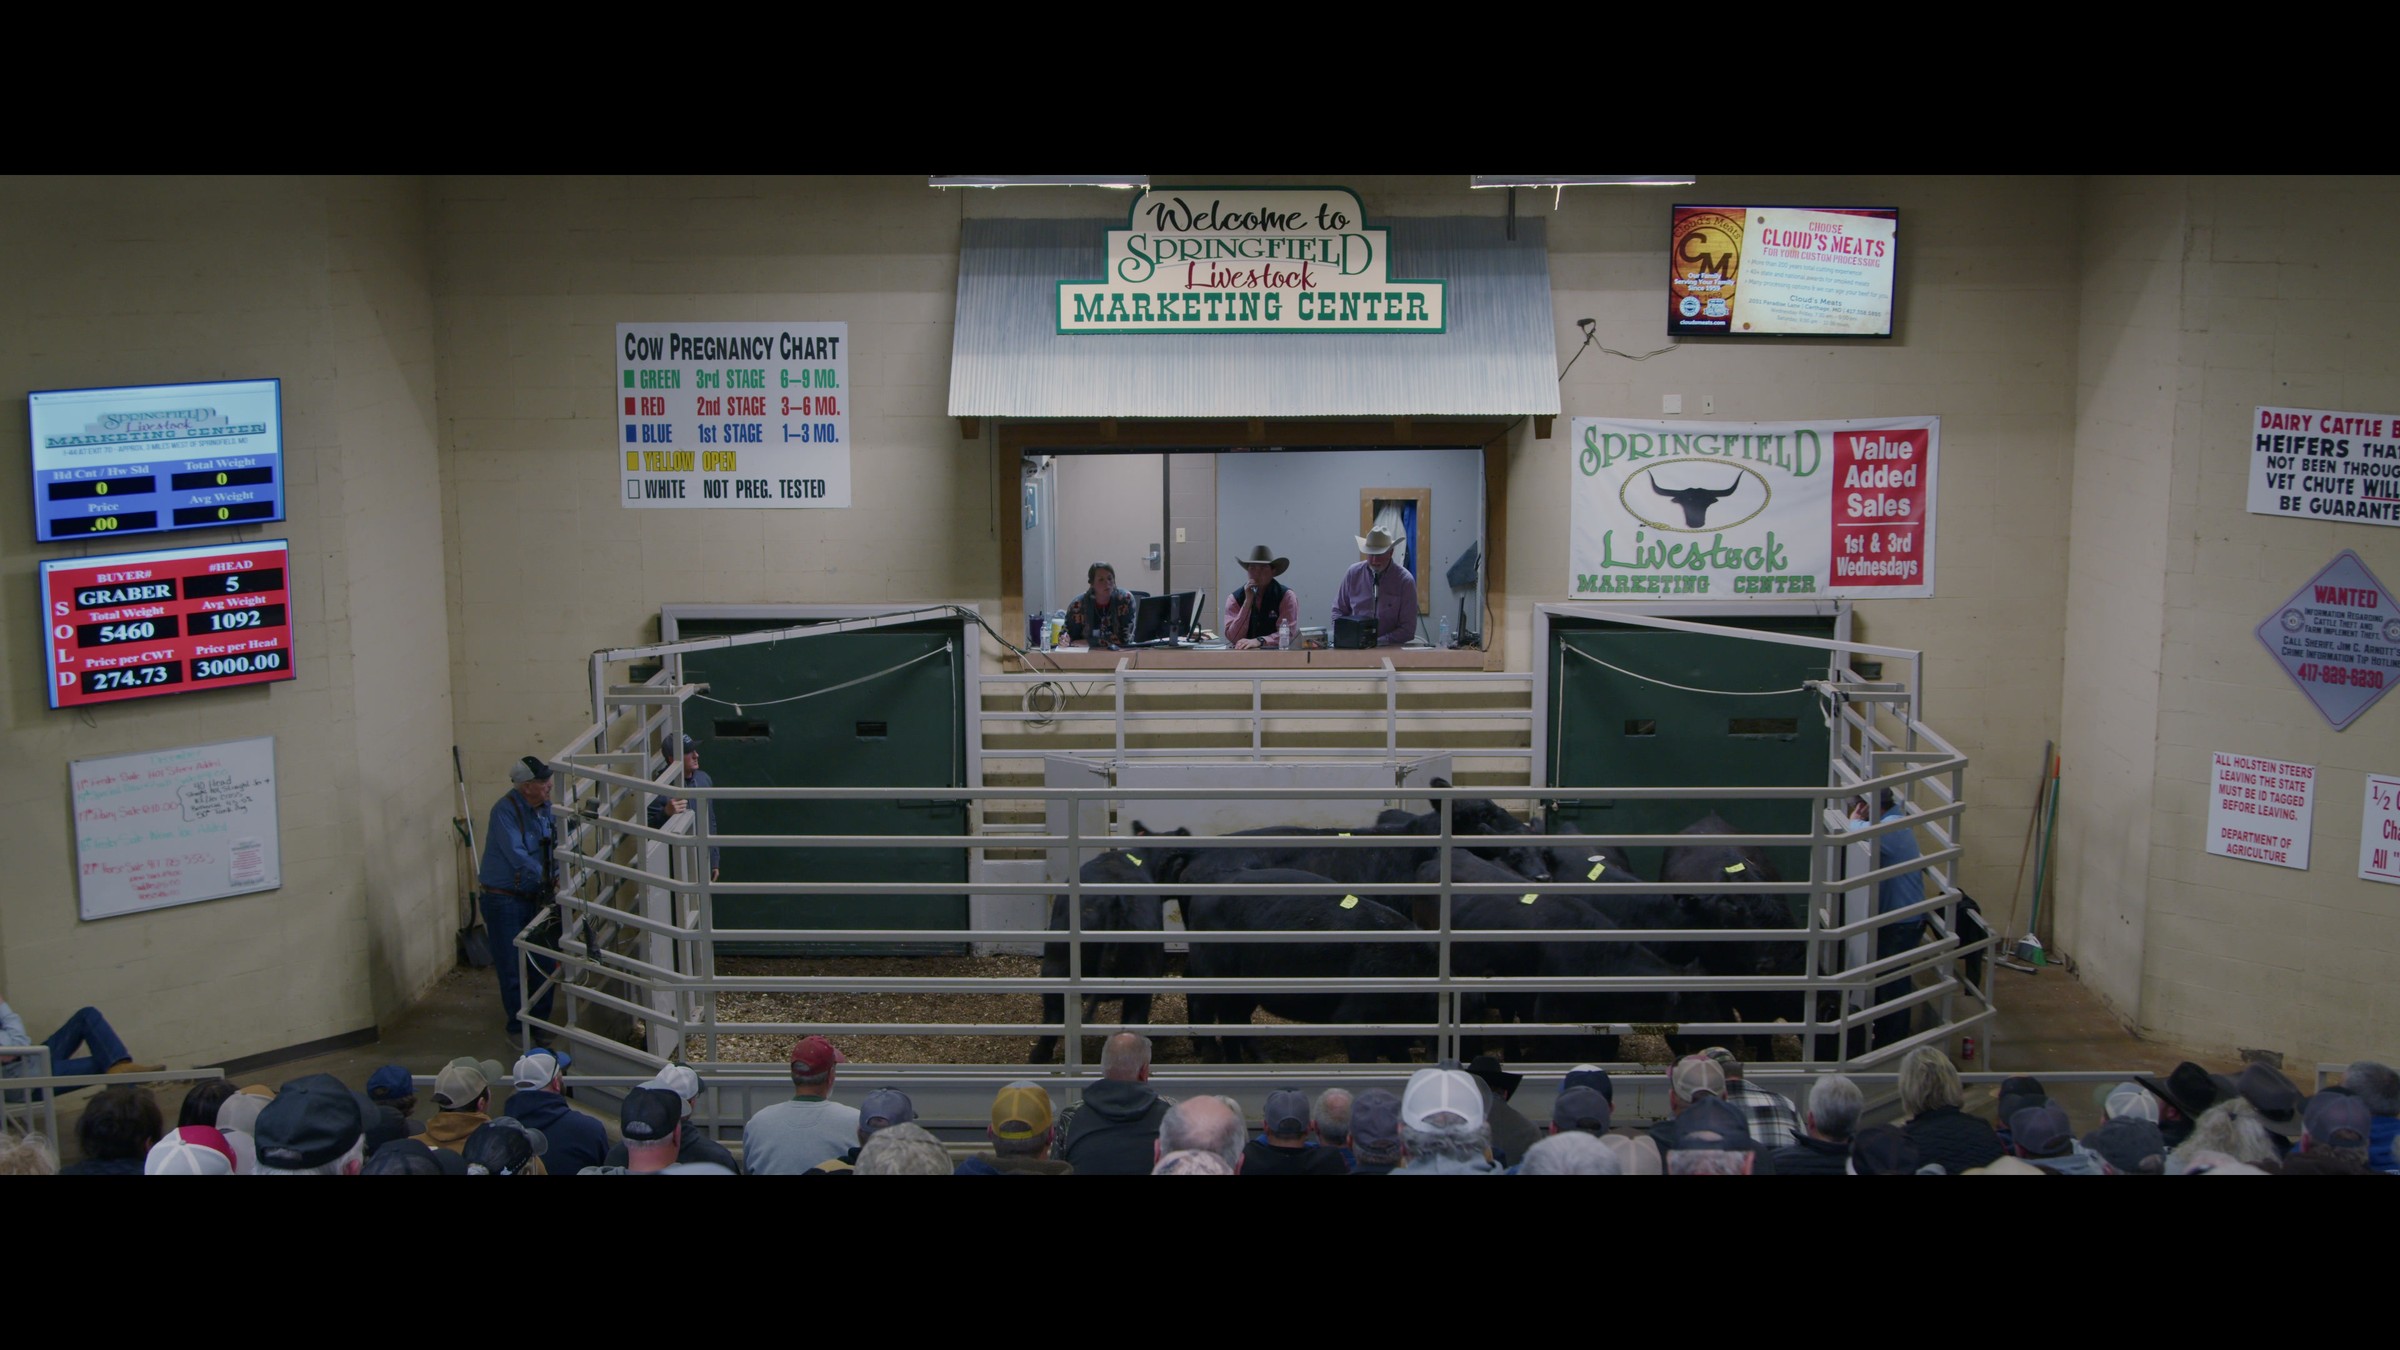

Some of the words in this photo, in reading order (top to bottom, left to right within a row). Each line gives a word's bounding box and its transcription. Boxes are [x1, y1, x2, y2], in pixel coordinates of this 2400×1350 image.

[1146, 197, 1307, 232] Welcome
[1316, 202, 1349, 230] to
[1808, 221, 1843, 234] CHOOSE
[1762, 228, 1827, 251] CLOUD'S
[1831, 235, 1885, 258] MEATS
[1117, 232, 1372, 283] SPRINGFIELD
[1763, 247, 1778, 257] FOR
[1780, 249, 1799, 260] YOUR
[1801, 250, 1831, 263] CUSTOM
[1832, 255, 1880, 268] PROCESSING
[1185, 260, 1317, 291] Livestock
[1073, 292, 1282, 322] MARKETING
[1299, 292, 1429, 321] CENTER
[1790, 294, 1818, 304] Cloud's
[1820, 298, 1843, 307] Meats
[625, 333, 663, 361] COW
[670, 333, 775, 361] PREGNANCY
[779, 332, 840, 360] CHART
[640, 369, 680, 389] GREEN
[696, 369, 720, 388] 3rd
[726, 369, 765, 389] STAGE
[814, 369, 840, 389] MO.
[641, 397, 665, 416] RED
[697, 396, 720, 416] 2nd
[727, 396, 766, 416] STAGE
[815, 396, 841, 416] MO.
[103, 408, 209, 430] SPRINGFIELD
[125, 419, 192, 432] Livestock
[2260, 411, 2312, 432] DAIRY
[2320, 415, 2382, 438] CATTLE
[47, 430, 176, 447] MARKETING
[187, 423, 264, 437] CENTER
[642, 424, 673, 443] BLUE
[698, 423, 717, 443] 1st
[723, 423, 763, 443] STAGE
[814, 423, 839, 443] MO.
[1579, 425, 1821, 477] SPRINGFIELD
[1849, 436, 1913, 461] Value
[2256, 434, 2350, 458] HEIFERS
[184, 460, 212, 472] Total
[215, 457, 256, 471] Weight
[643, 451, 695, 471] YELLOW
[702, 451, 737, 471] OPEN
[2266, 456, 2295, 470] NOT
[2302, 458, 2336, 474] BEEN
[54, 470, 72, 481] Hd
[75, 468, 97, 479] Cnt
[107, 466, 127, 477] Hw
[130, 464, 150, 475] Sld
[216, 472, 228, 486] 0
[1844, 464, 1916, 489] Added
[95, 482, 108, 495] 0
[644, 479, 686, 499] WHITE
[704, 479, 729, 499] NOT
[736, 479, 772, 499] PREG.
[779, 479, 826, 499] TESTED
[2266, 472, 2296, 490] VET
[2303, 476, 2354, 495] CHUTE
[2363, 479, 2400, 498] WILL
[88, 502, 119, 513] Price
[190, 494, 212, 506] Avg
[214, 490, 254, 502] Weight
[1846, 494, 1911, 519] Sales
[2279, 496, 2302, 511] BE
[90, 517, 118, 531] .00
[218, 507, 229, 520] 0
[1600, 530, 1788, 572] Livestock
[1844, 534, 1864, 554] 1st
[1871, 535, 1881, 553] &
[1888, 533, 1912, 553] 3rd
[209, 559, 253, 573] #HEAD
[1836, 556, 1918, 579] Wednesdays
[96, 570, 152, 584] BUYER#
[226, 576, 239, 593] 5
[1577, 574, 1711, 594] MARKETING
[1733, 574, 1816, 593] CENTER
[78, 584, 171, 606] GRABER
[202, 599, 224, 611] Avg
[226, 595, 266, 608] Weight
[2314, 585, 2378, 609] WANTED
[90, 610, 120, 622] Total
[124, 606, 164, 620] Weight
[210, 611, 261, 631] 1092
[2304, 608, 2345, 619] INFORMATION
[2347, 612, 2383, 623] REGARDING
[2313, 617, 2336, 627] CATTLE
[2339, 620, 2357, 629] THEFT
[2360, 622, 2373, 630] AND
[100, 622, 155, 643] 5460
[2305, 625, 2322, 634] FARM
[2324, 627, 2358, 638] IMPLEMENT
[196, 644, 226, 656] Price
[228, 642, 246, 655] per
[249, 637, 278, 650] Head
[2283, 636, 2302, 646] CALL
[2337, 642, 2351, 652] JIM
[2353, 643, 2361, 653] C.
[2364, 645, 2400, 657] ARNOTT'S
[86, 656, 117, 669] Price
[119, 655, 139, 667] per
[141, 649, 174, 662] CWT
[197, 653, 280, 678] 3000.00
[2281, 647, 2304, 658] CRIME
[2306, 649, 2354, 663] INFORMATION
[2357, 655, 2369, 665] TIP
[2371, 656, 2400, 669] HOTLINE
[94, 666, 168, 690] 274.73
[2216, 755, 2231, 767] ALL
[2233, 758, 2276, 773] HOLSTEIN
[2278, 764, 2313, 779] STEERS
[2220, 769, 2257, 785] LEAVING
[2259, 774, 2276, 789] THE
[2279, 778, 2306, 793] STATE
[2218, 784, 2242, 796] MUST
[2244, 788, 2256, 800] BE
[2258, 789, 2268, 801] ID
[2270, 791, 2305, 807] TAGGED
[2222, 799, 2256, 814] BEFORE
[2258, 804, 2298, 821] LEAVING.
[2221, 827, 2278, 848] DEPARTMENT
[2280, 837, 2292, 850] OF
[2226, 843, 2287, 864] AGRICULTURE
[2372, 848, 2388, 870] All
